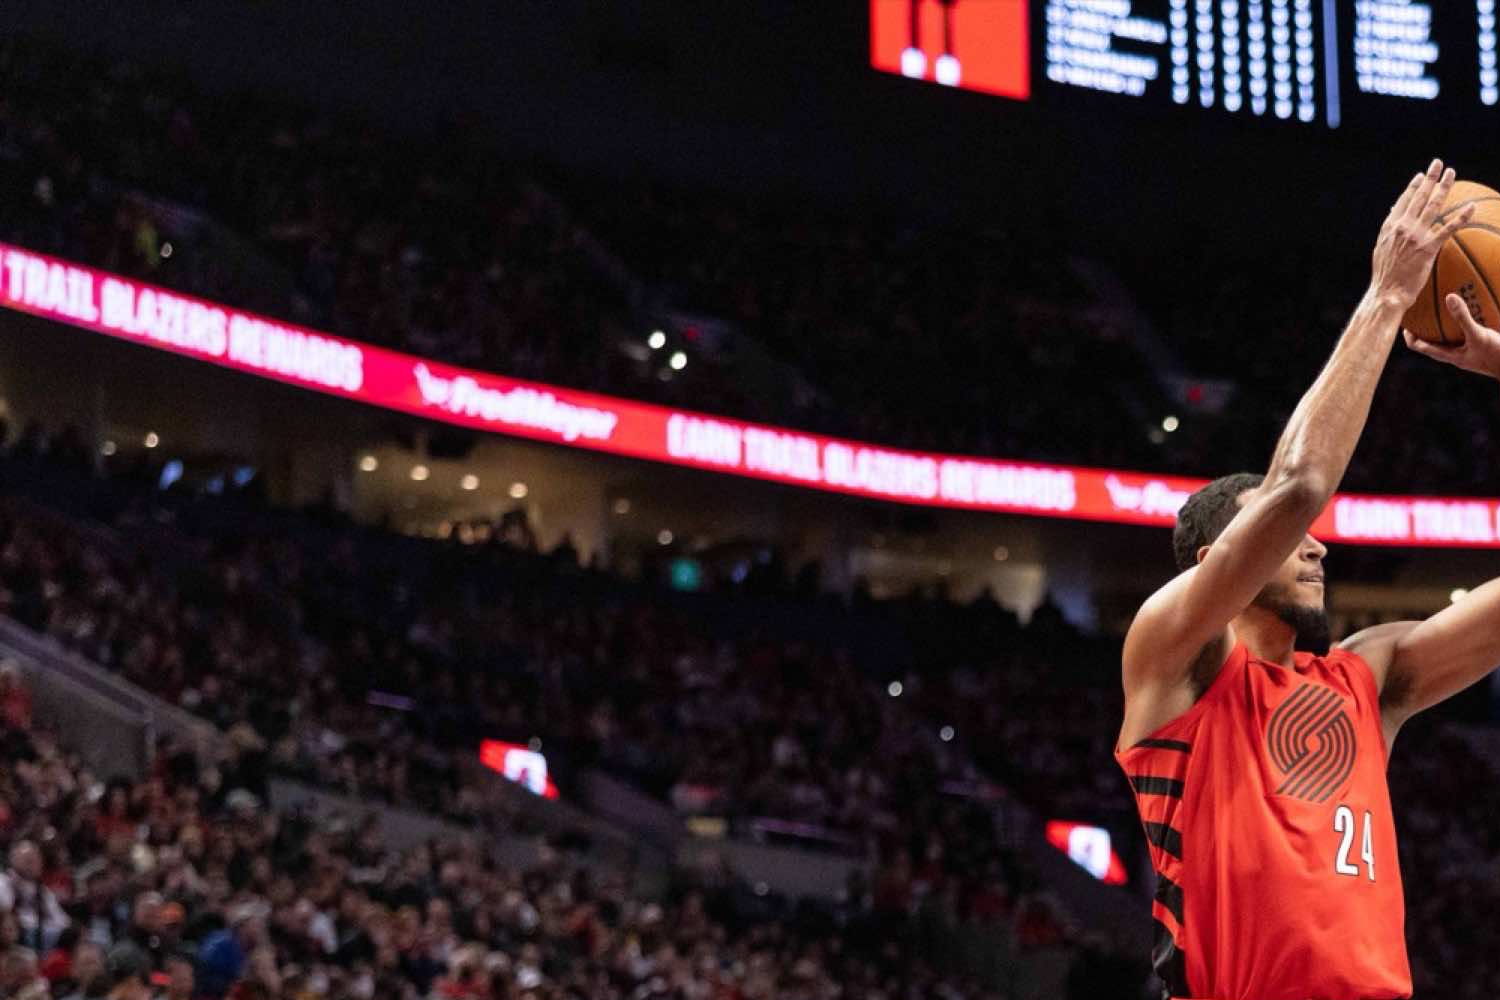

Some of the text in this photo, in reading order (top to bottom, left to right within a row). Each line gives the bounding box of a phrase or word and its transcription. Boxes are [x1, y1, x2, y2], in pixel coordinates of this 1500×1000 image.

[5, 249, 98, 323] TRAIL
[100, 277, 227, 357] BLAZERS
[1333, 804, 1378, 882] 24
